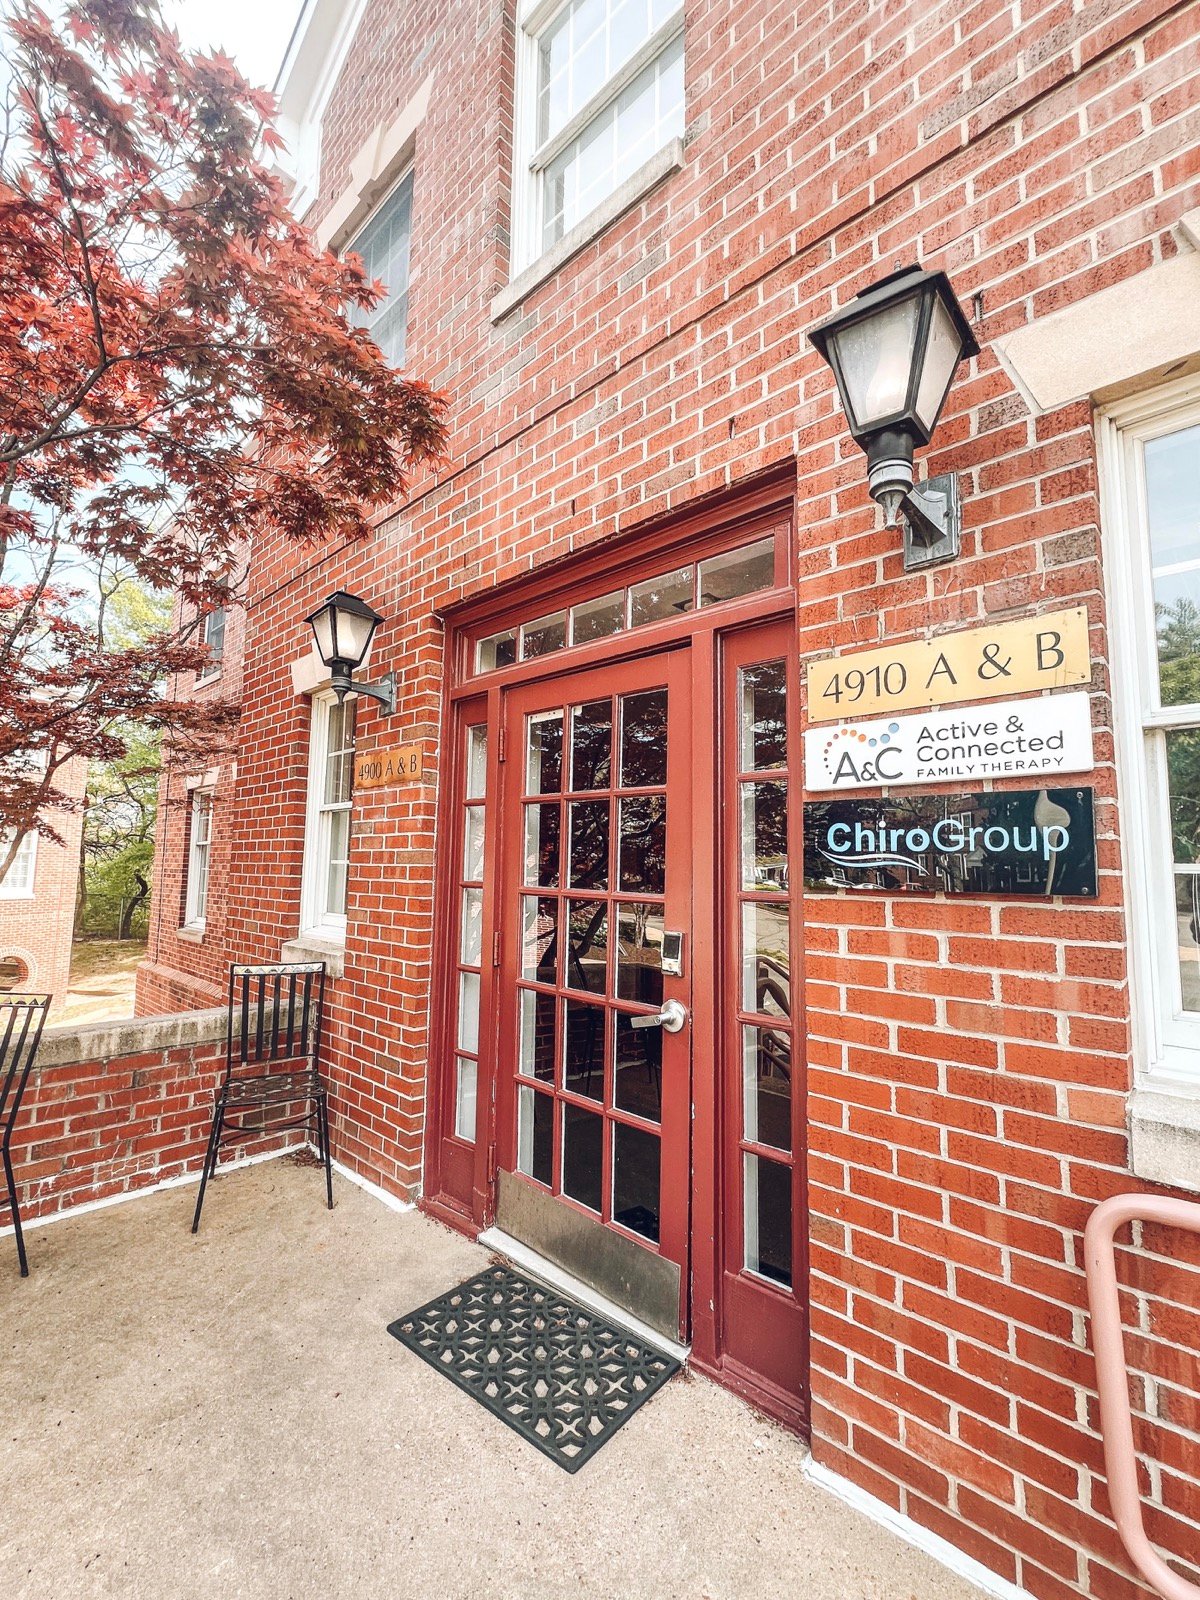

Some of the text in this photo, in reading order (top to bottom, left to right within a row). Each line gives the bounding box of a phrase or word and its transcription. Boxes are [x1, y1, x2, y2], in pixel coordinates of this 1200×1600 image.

[822, 631, 1065, 704] 4910 A & B
[916, 715, 1024, 744] Active &
[917, 730, 1064, 762] Connected
[359, 754, 417, 780] 4900 A & B
[832, 746, 903, 785] A&C
[917, 757, 1065, 778] FAMILY THERAPY
[826, 819, 1070, 861] ChiroGroup
